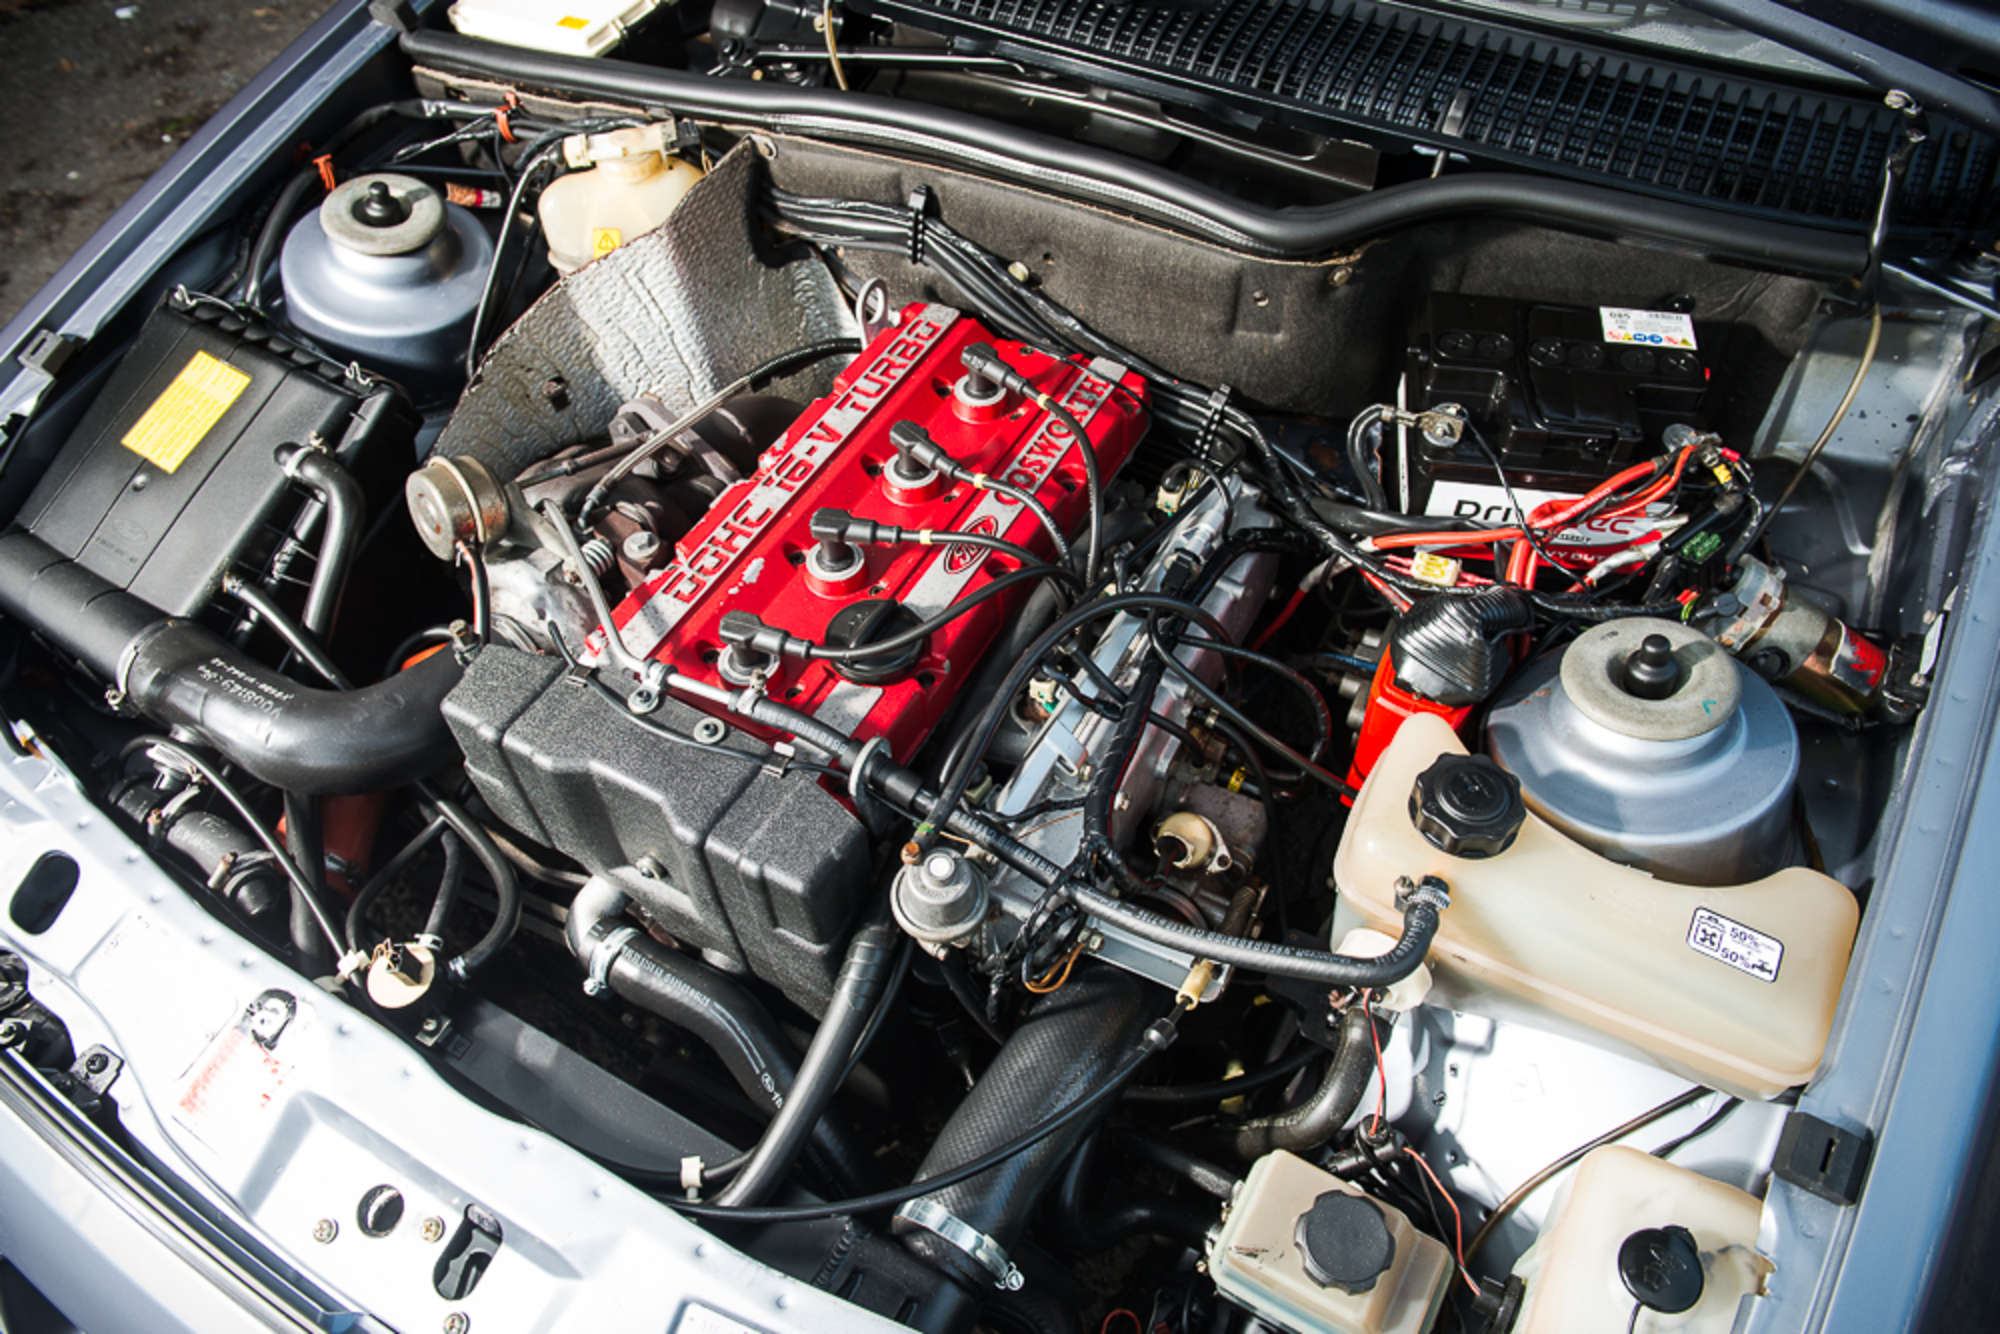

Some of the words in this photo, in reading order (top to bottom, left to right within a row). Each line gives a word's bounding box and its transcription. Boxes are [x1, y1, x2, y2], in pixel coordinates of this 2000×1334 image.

[662, 500, 774, 604] DOHC
[762, 420, 845, 492] 16-V
[835, 317, 943, 414] TURBO
[1729, 926, 1760, 948] 50%
[1720, 947, 1751, 969] 50%
